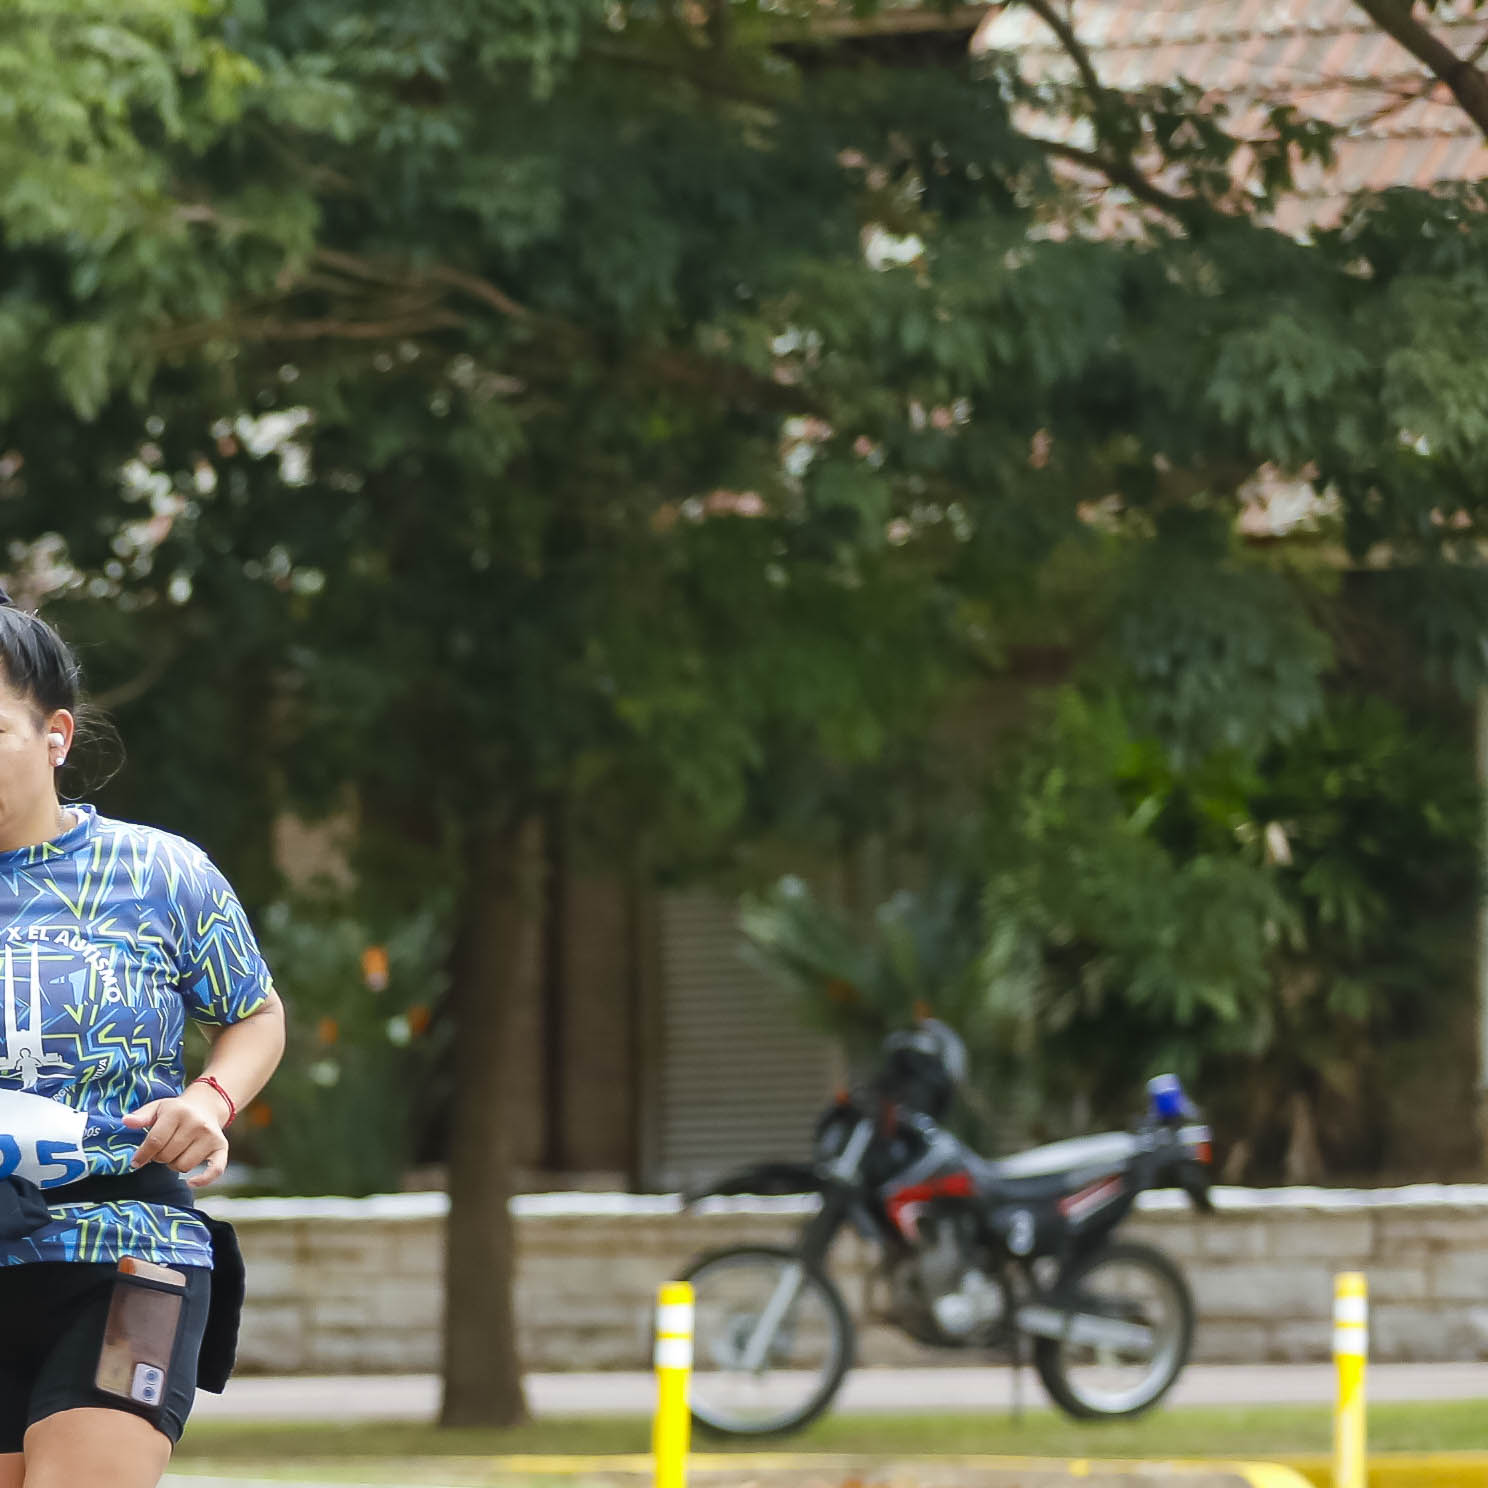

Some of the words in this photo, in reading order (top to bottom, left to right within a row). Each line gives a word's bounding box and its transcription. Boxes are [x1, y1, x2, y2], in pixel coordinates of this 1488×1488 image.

[8, 926, 22, 942] X
[28, 926, 50, 941] EL
[54, 930, 121, 1003] AUTISMO
